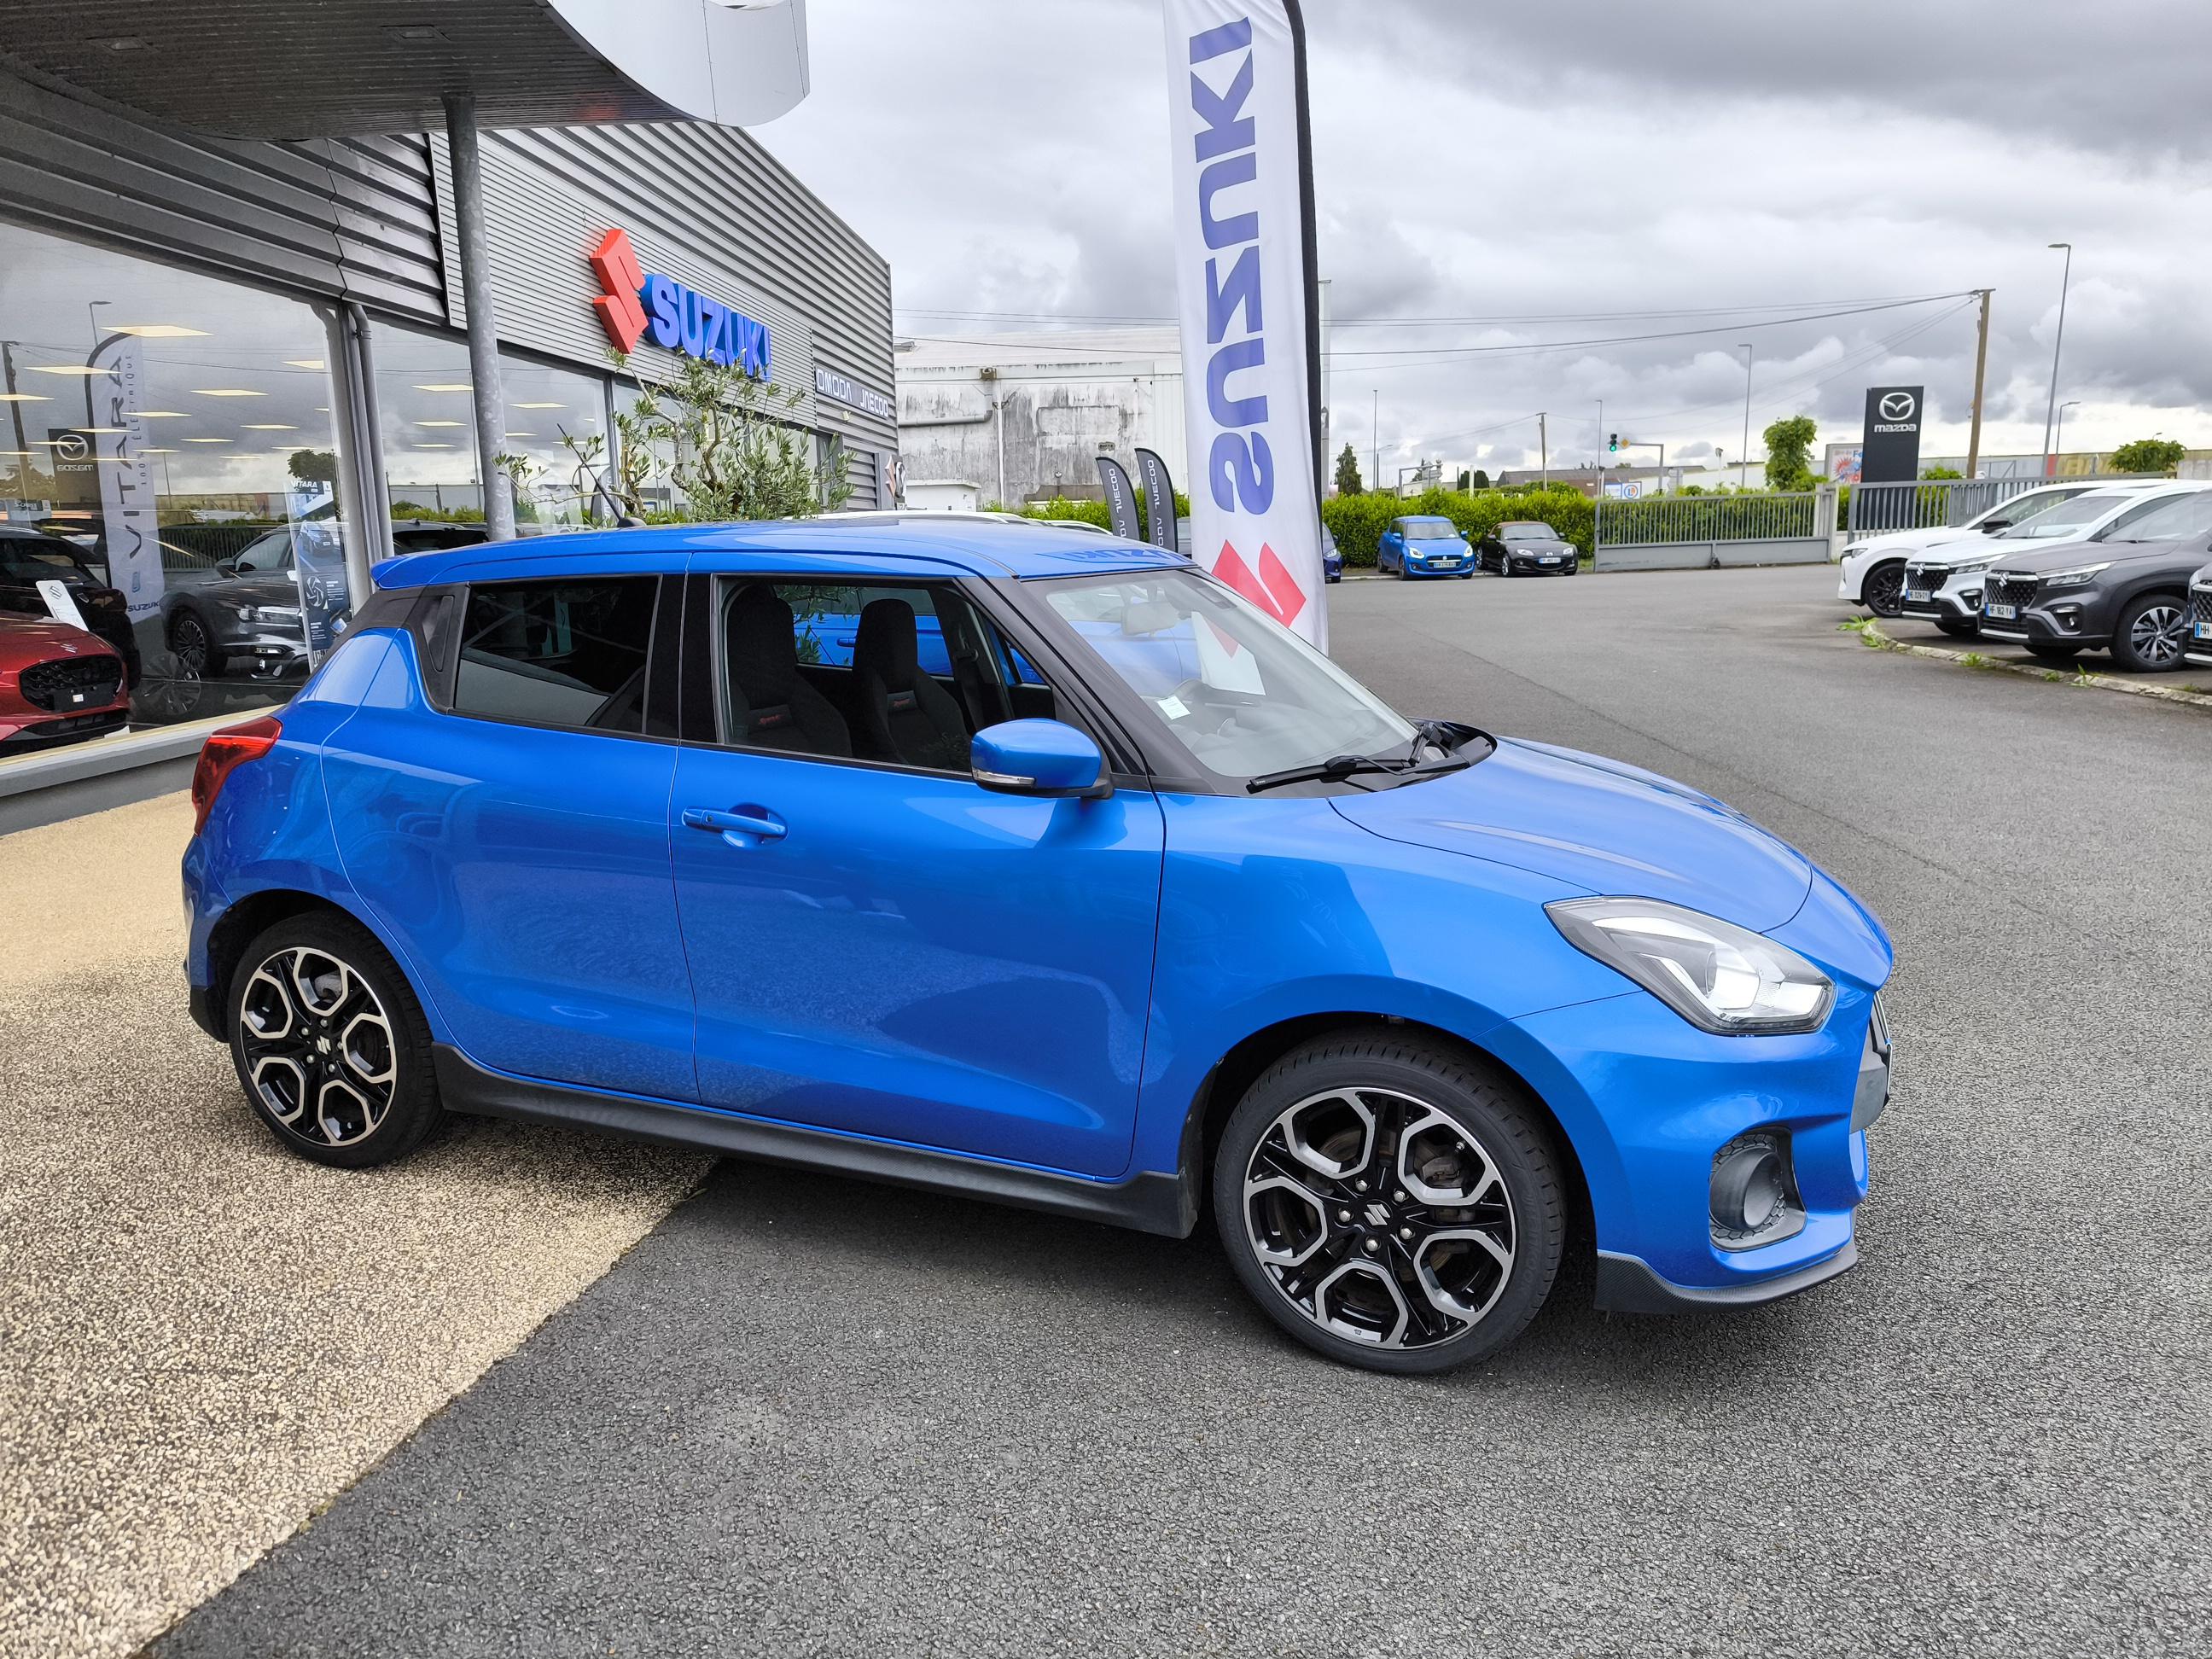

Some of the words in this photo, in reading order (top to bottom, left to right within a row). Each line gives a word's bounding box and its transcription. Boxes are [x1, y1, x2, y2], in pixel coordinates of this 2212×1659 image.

[640, 273, 772, 383] SUZUKI
[817, 368, 853, 403] OMODA
[859, 388, 888, 418] JAECOO
[1873, 423, 1918, 433] mazda
[108, 355, 143, 559] VITARA
[127, 601, 160, 613] SUZUK
